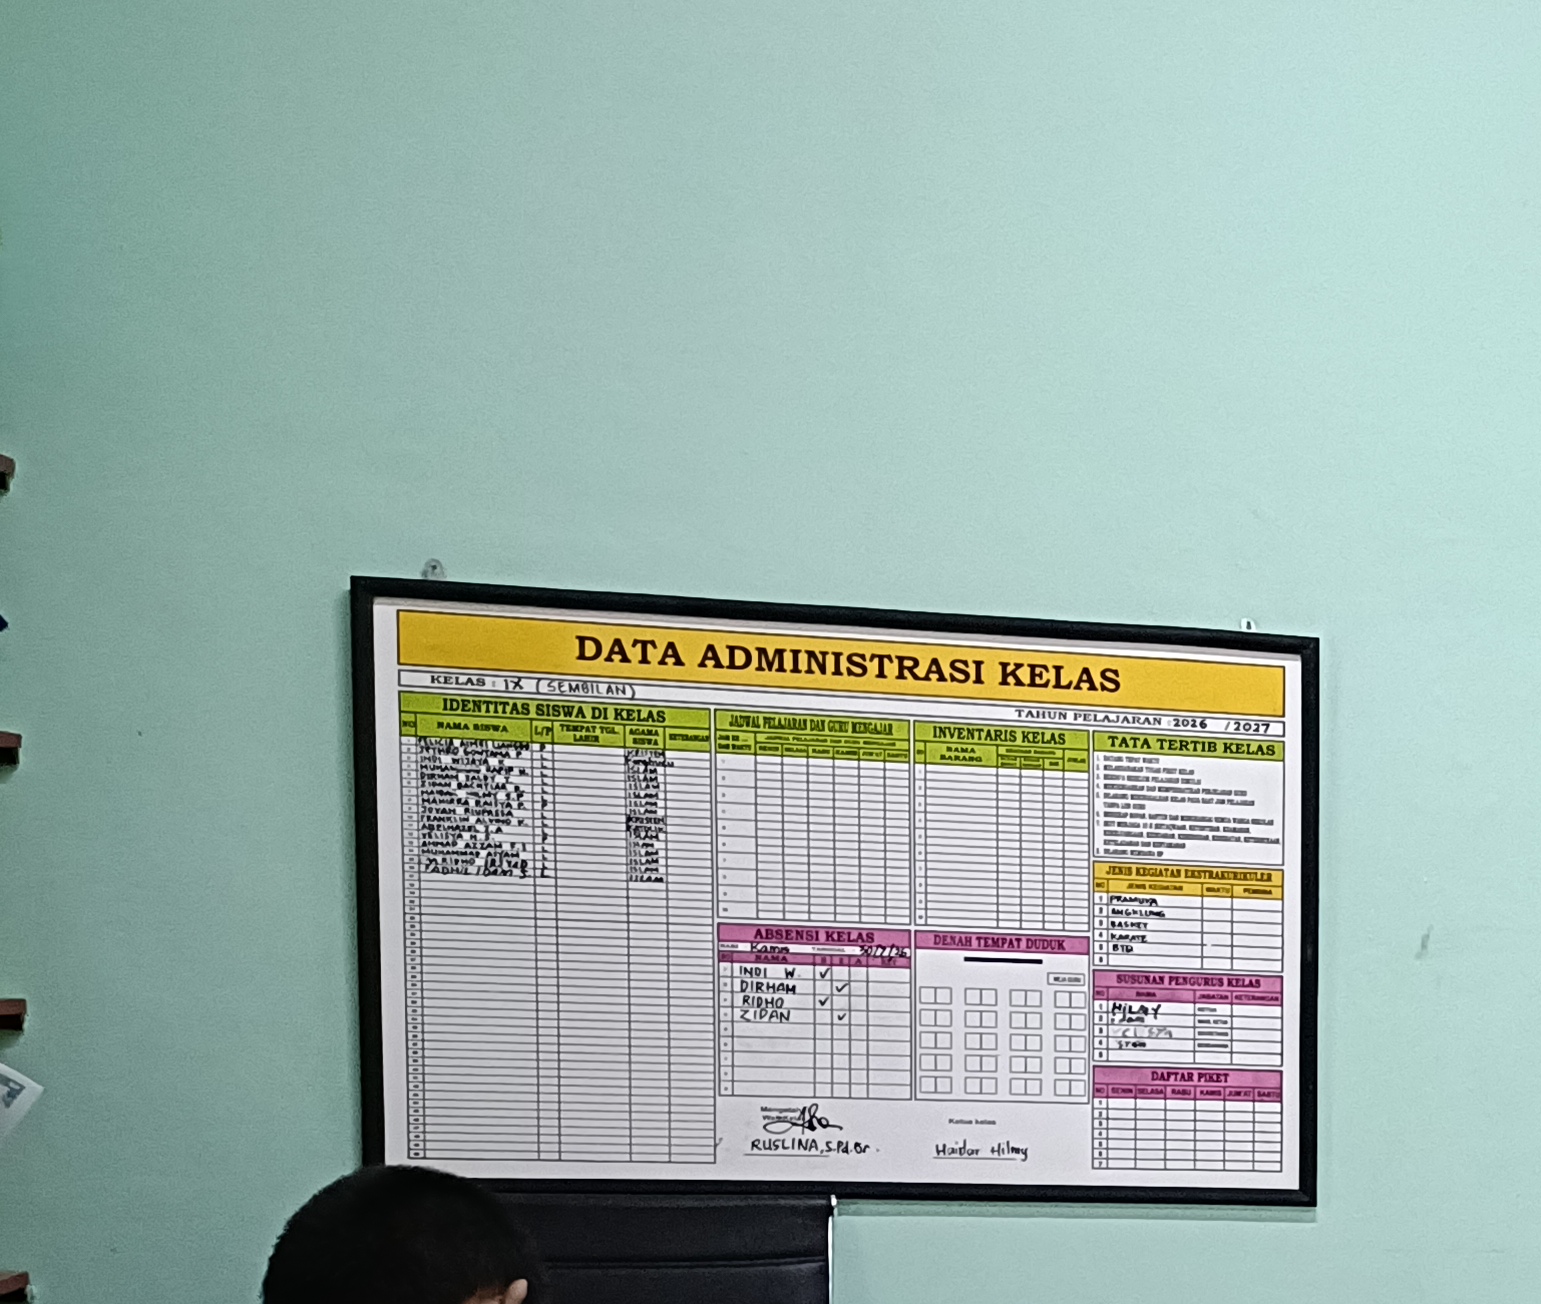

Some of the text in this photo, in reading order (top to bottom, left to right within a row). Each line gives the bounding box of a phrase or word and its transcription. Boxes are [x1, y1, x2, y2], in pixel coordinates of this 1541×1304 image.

[575, 634, 1121, 693] DATA ADMINISTRASI KELAS
[430, 675, 486, 687] KELAS
[442, 698, 667, 723] IDENTITAS SISWA DI KELAS
[728, 714, 761, 730] JADWAL
[762, 716, 809, 731] PELAJARAN
[810, 719, 826, 733] DAN
[1015, 709, 1068, 721] TAHUN
[1073, 713, 1162, 726] PELAJARAN
[1173, 718, 1208, 729] 2026
[933, 725, 1066, 745] INVENTARIS KELAS
[1107, 735, 1276, 756] TATA TERTIB KELAS
[754, 928, 875, 944] ABSENSI KELAS
[933, 934, 1067, 951] DENAH TEMPAT DUDUK
[739, 966, 768, 979] INDI
[740, 981, 797, 995] DIRHAM
[1116, 973, 1261, 989] SUSUNAN PENGURUS KELAS
[742, 996, 785, 1009] RIDHO
[739, 1009, 791, 1023] ZIDAN
[1151, 1071, 1229, 1084] DAFTAR PIKET
